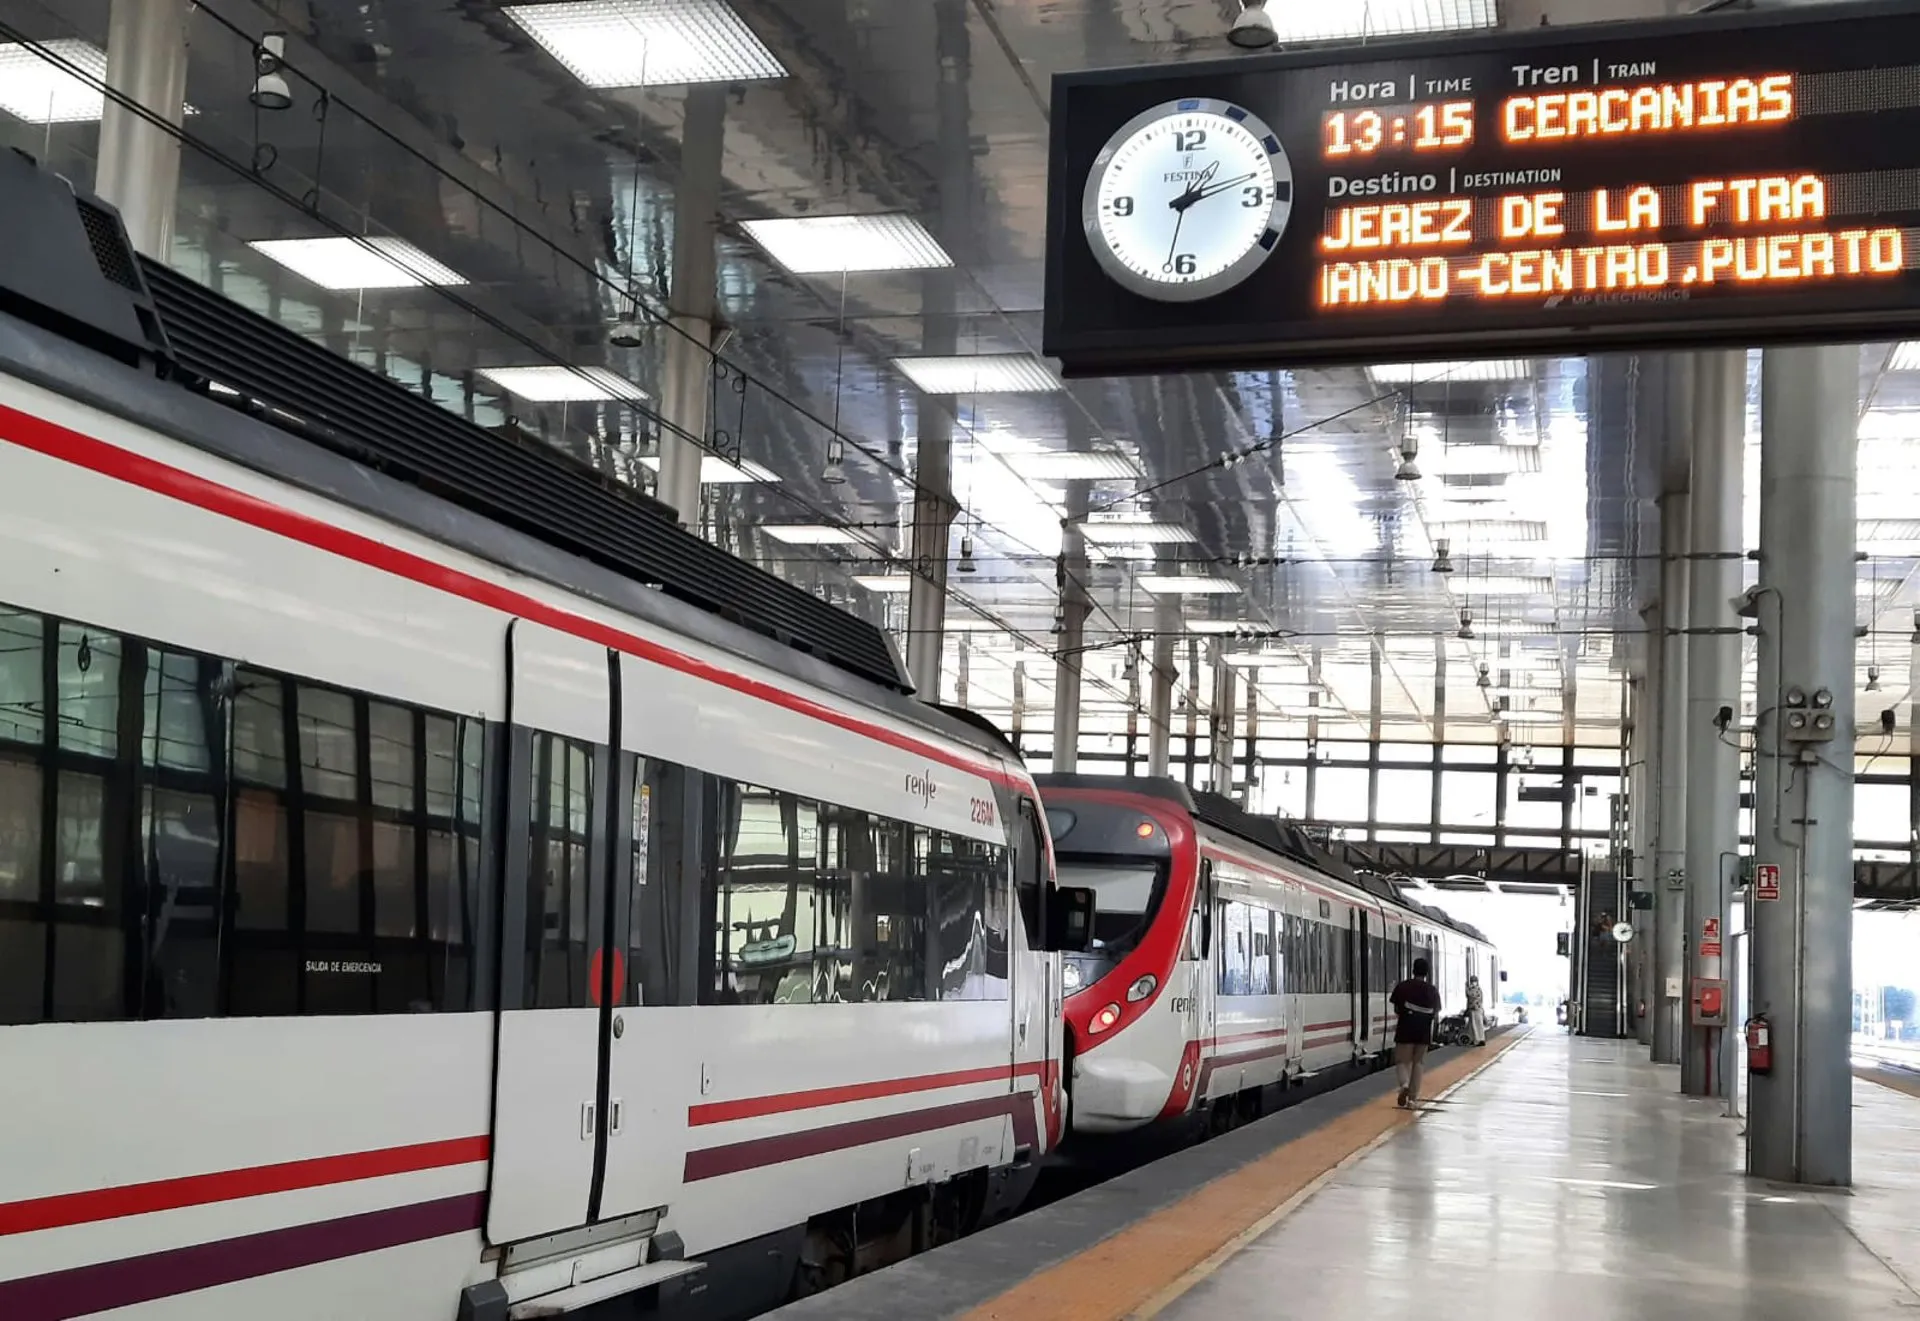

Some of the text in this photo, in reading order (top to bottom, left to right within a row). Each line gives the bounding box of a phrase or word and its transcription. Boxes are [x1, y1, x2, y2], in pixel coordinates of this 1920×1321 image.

[1512, 61, 1657, 87] Tren TRAIN
[1329, 77, 1473, 102] Hora TIME
[1504, 74, 1792, 142] CERCANIAS
[1171, 129, 1207, 152] 12
[1326, 101, 1472, 155] 13:15
[1163, 170, 1213, 183] FESTINA
[1328, 167, 1562, 198] Destino DESTINATION
[1113, 195, 1134, 217] 9
[1241, 186, 1264, 208] 3
[1322, 174, 1826, 250] JEREZ DE LA FTRA
[1175, 253, 1197, 275] 6
[905, 768, 937, 809] renfe
[305, 960, 329, 972] SALIDA
[330, 961, 341, 972] DE
